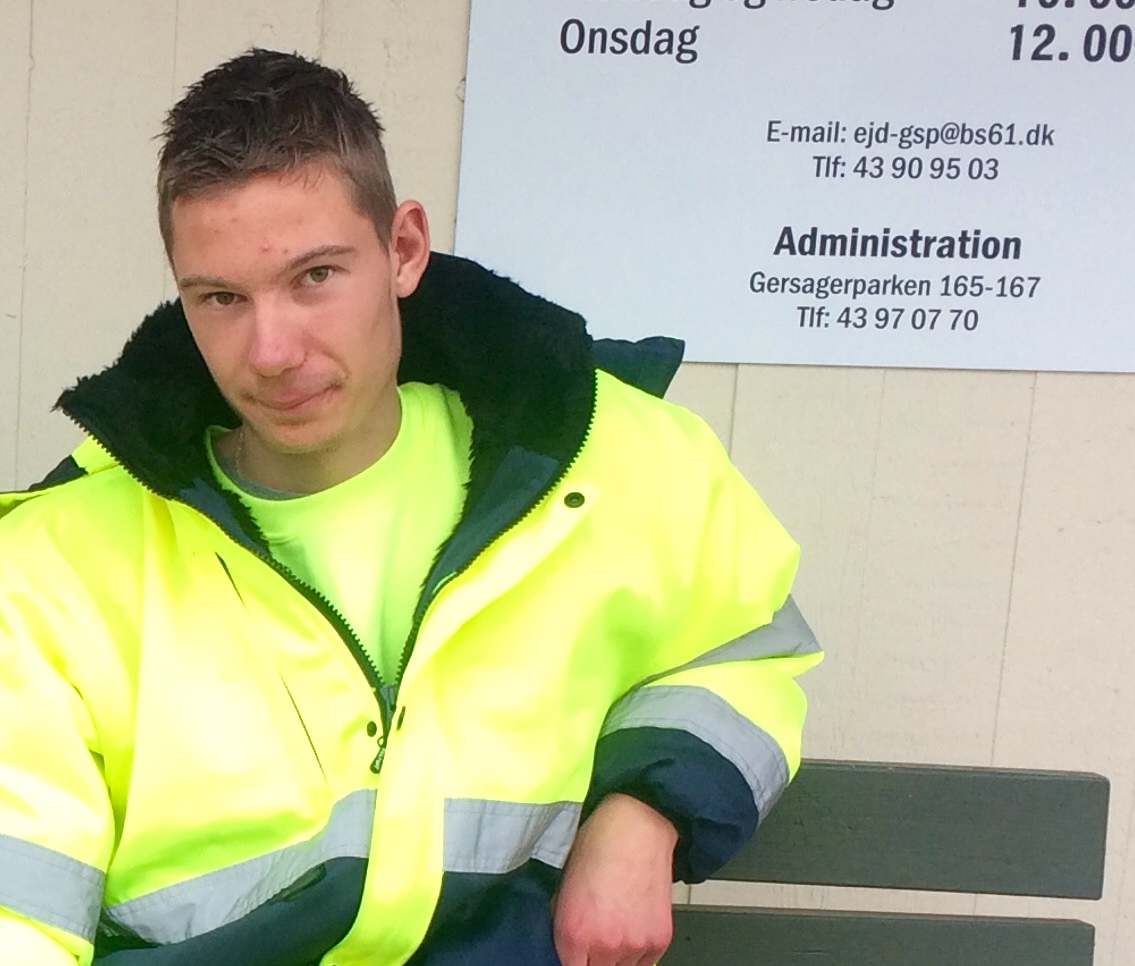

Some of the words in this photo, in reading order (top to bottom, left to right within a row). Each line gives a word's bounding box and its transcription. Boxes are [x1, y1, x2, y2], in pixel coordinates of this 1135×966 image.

[560, 18, 700, 65] Onsdag
[766, 120, 847, 144] E-mail:
[853, 121, 1055, 151] ejd-gsp@bs61.dk
[812, 155, 846, 178] Tlf:
[852, 155, 884, 179] 43
[891, 156, 923, 179] 90
[929, 157, 961, 180] 95
[967, 157, 999, 181] 03
[772, 226, 1022, 260] Administration
[749, 271, 931, 299] Gersagerparken
[940, 275, 1041, 298] 165-167
[797, 305, 830, 328] Tlf:
[836, 306, 868, 329] 43
[874, 307, 905, 330] 97
[911, 308, 942, 330] 07
[949, 309, 979, 331] 70
